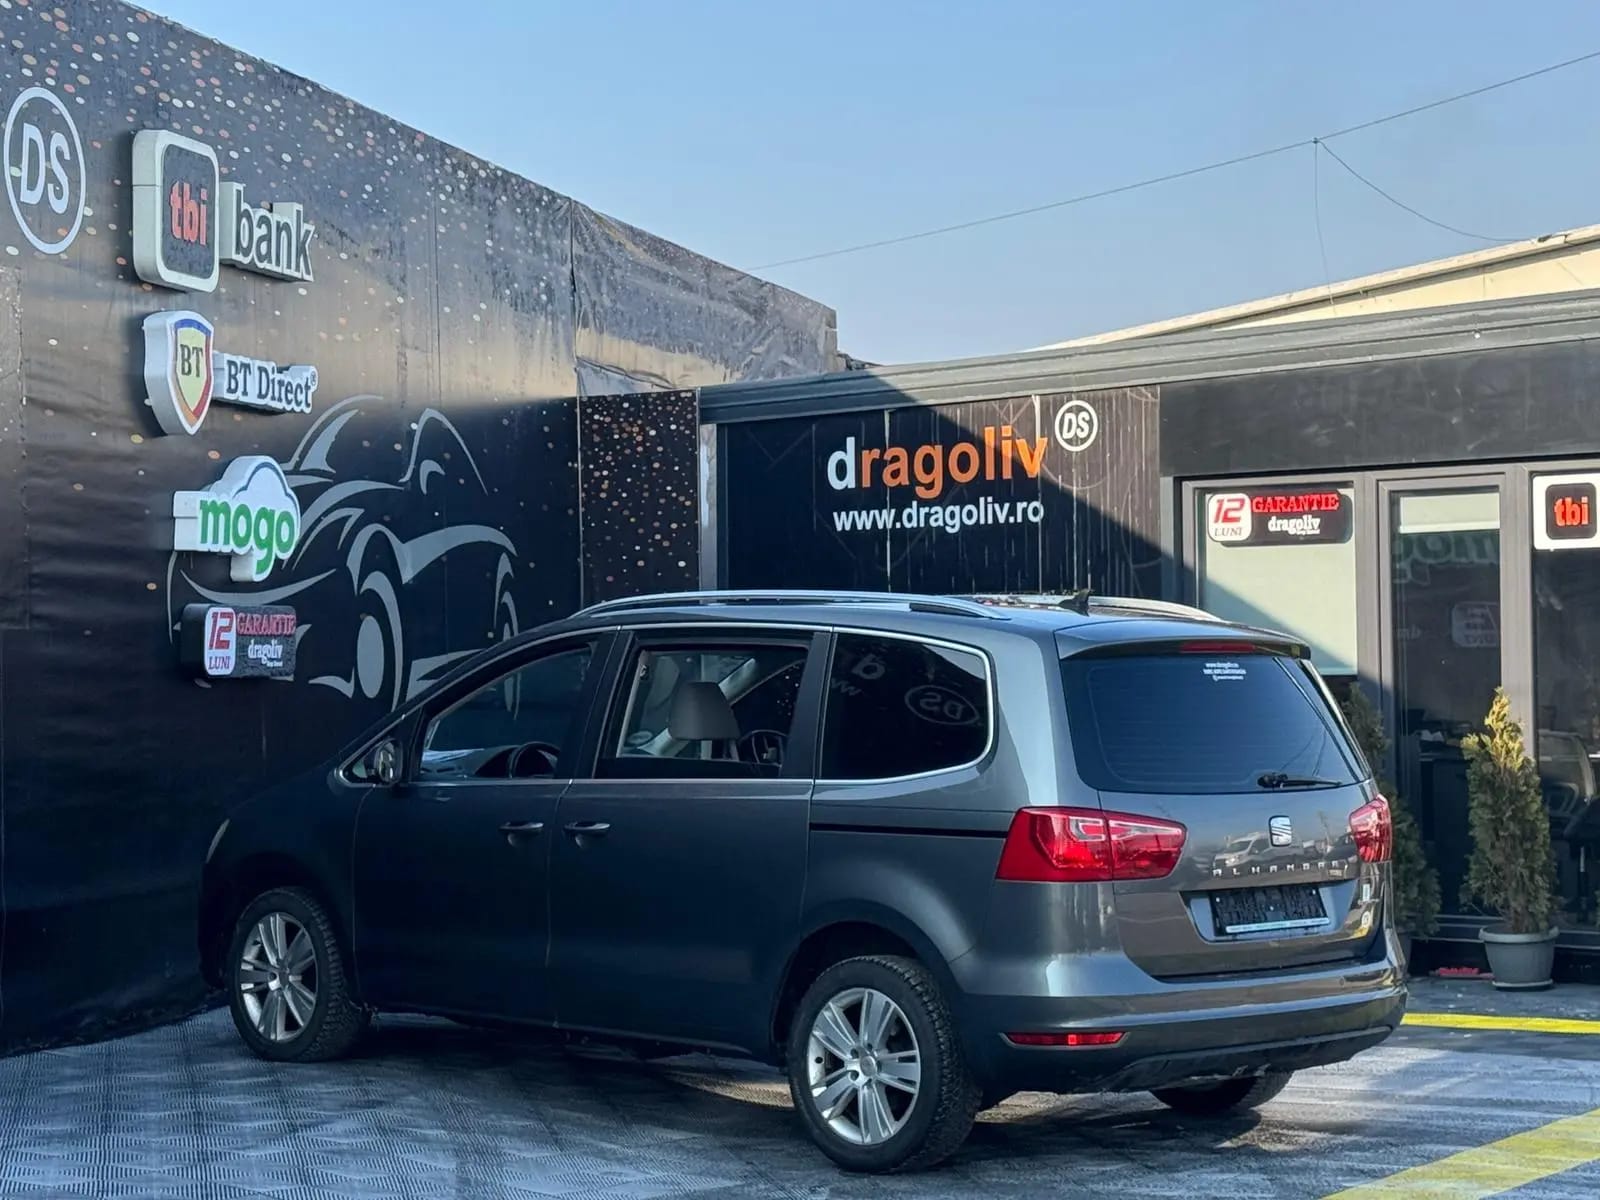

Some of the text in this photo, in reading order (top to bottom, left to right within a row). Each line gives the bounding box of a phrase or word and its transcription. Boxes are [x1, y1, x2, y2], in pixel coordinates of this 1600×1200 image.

[20, 122, 71, 215] DS
[169, 180, 314, 282] tbi bank
[180, 343, 204, 378] BT
[226, 359, 252, 396] BT
[1061, 411, 1091, 441] DS
[827, 424, 1049, 500] dragoliv
[833, 496, 1045, 534] www.dragoliv.ro
[1213, 497, 1246, 524] 12
[1252, 492, 1340, 514] GARANTIE
[1553, 495, 1590, 527] tbi
[200, 499, 296, 576] mogo
[1213, 526, 1243, 538] LUNI
[1267, 514, 1321, 535] dragoliv
[207, 610, 235, 652] 12
[237, 612, 297, 636] GARANTIE
[207, 655, 232, 671] LUNI
[247, 638, 284, 665] dragoliv
[1212, 860, 1341, 877] ALHAMBRA
